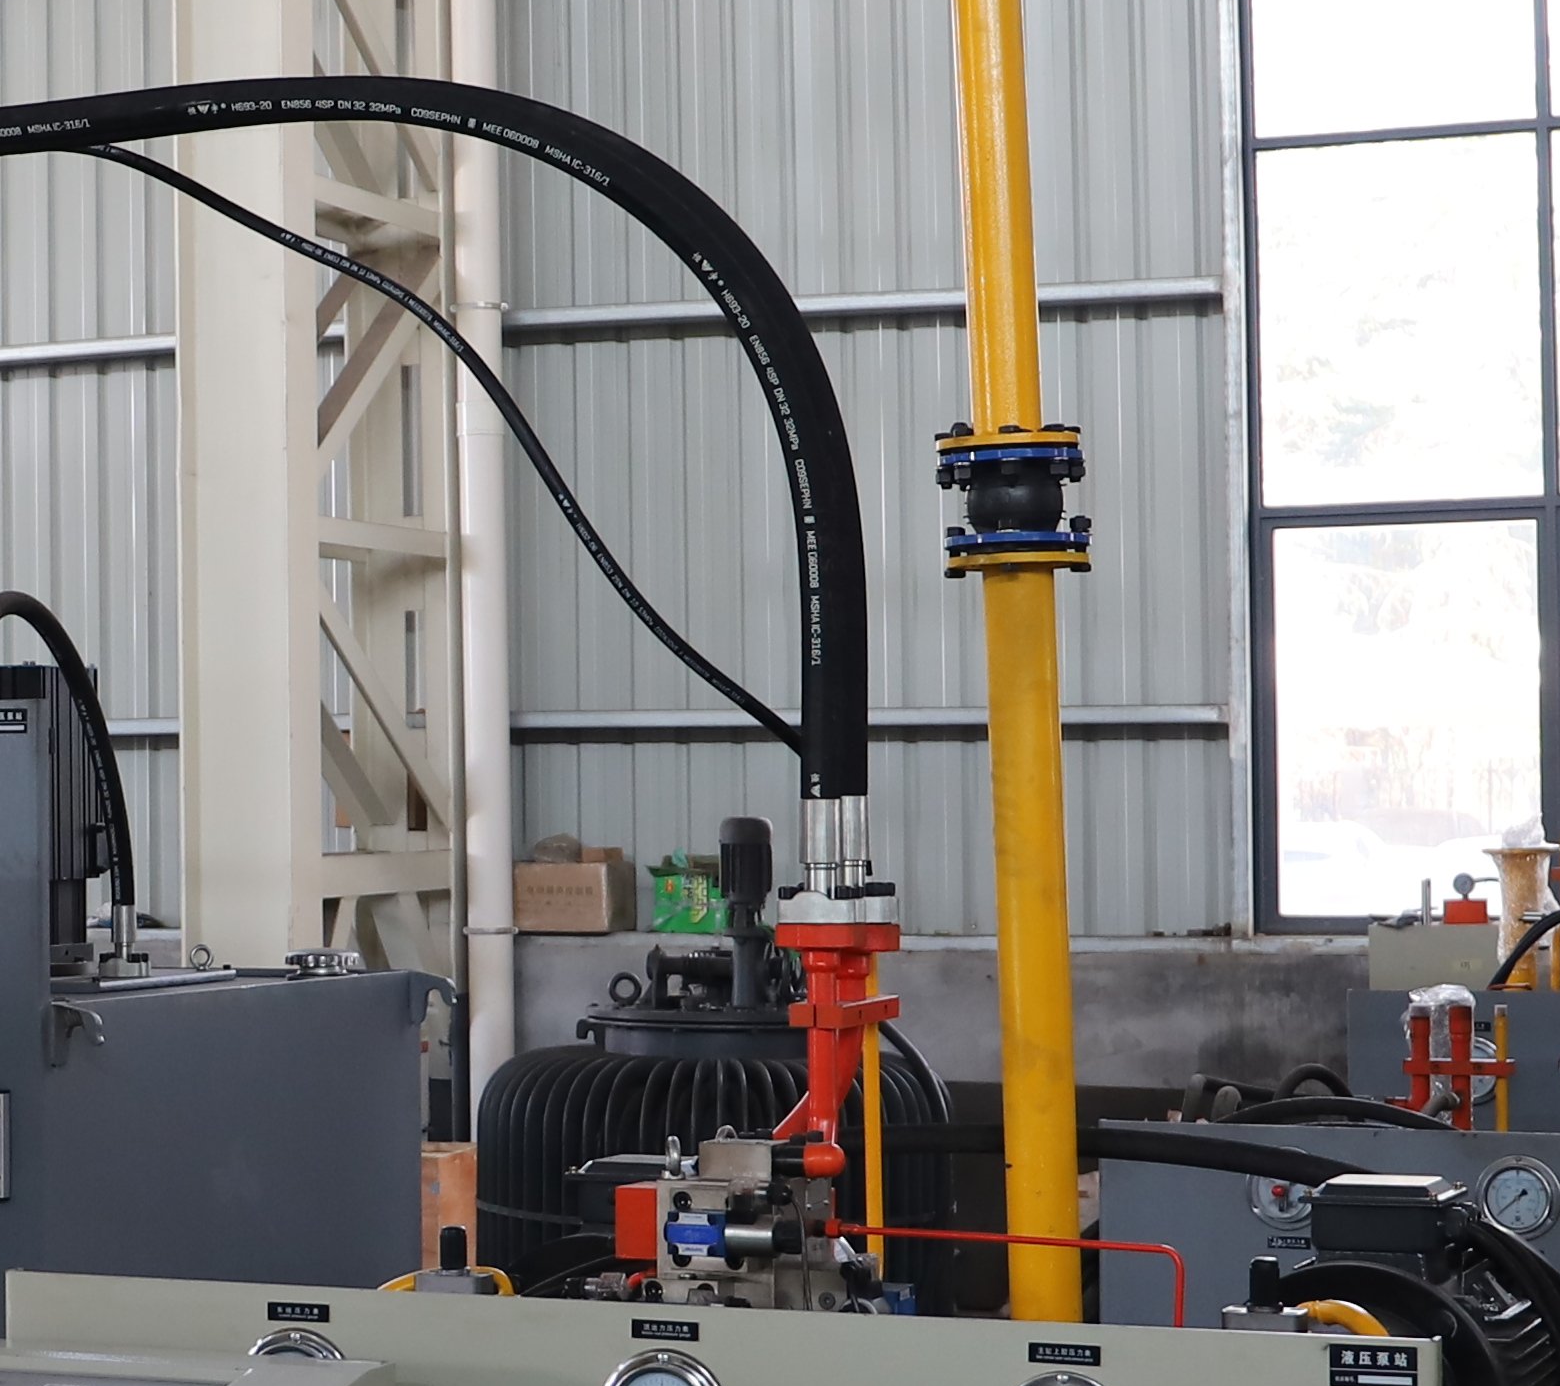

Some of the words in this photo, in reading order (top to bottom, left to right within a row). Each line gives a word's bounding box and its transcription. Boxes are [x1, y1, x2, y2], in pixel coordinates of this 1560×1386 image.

[337, 100, 352, 110] DN
[352, 100, 366, 111] 32
[368, 102, 402, 114] 32MPa
[773, 387, 785, 404] DN
[778, 401, 791, 416] 32
[783, 418, 800, 451] 32MPa
[1340, 1349, 1409, 1368] 液压泵站
